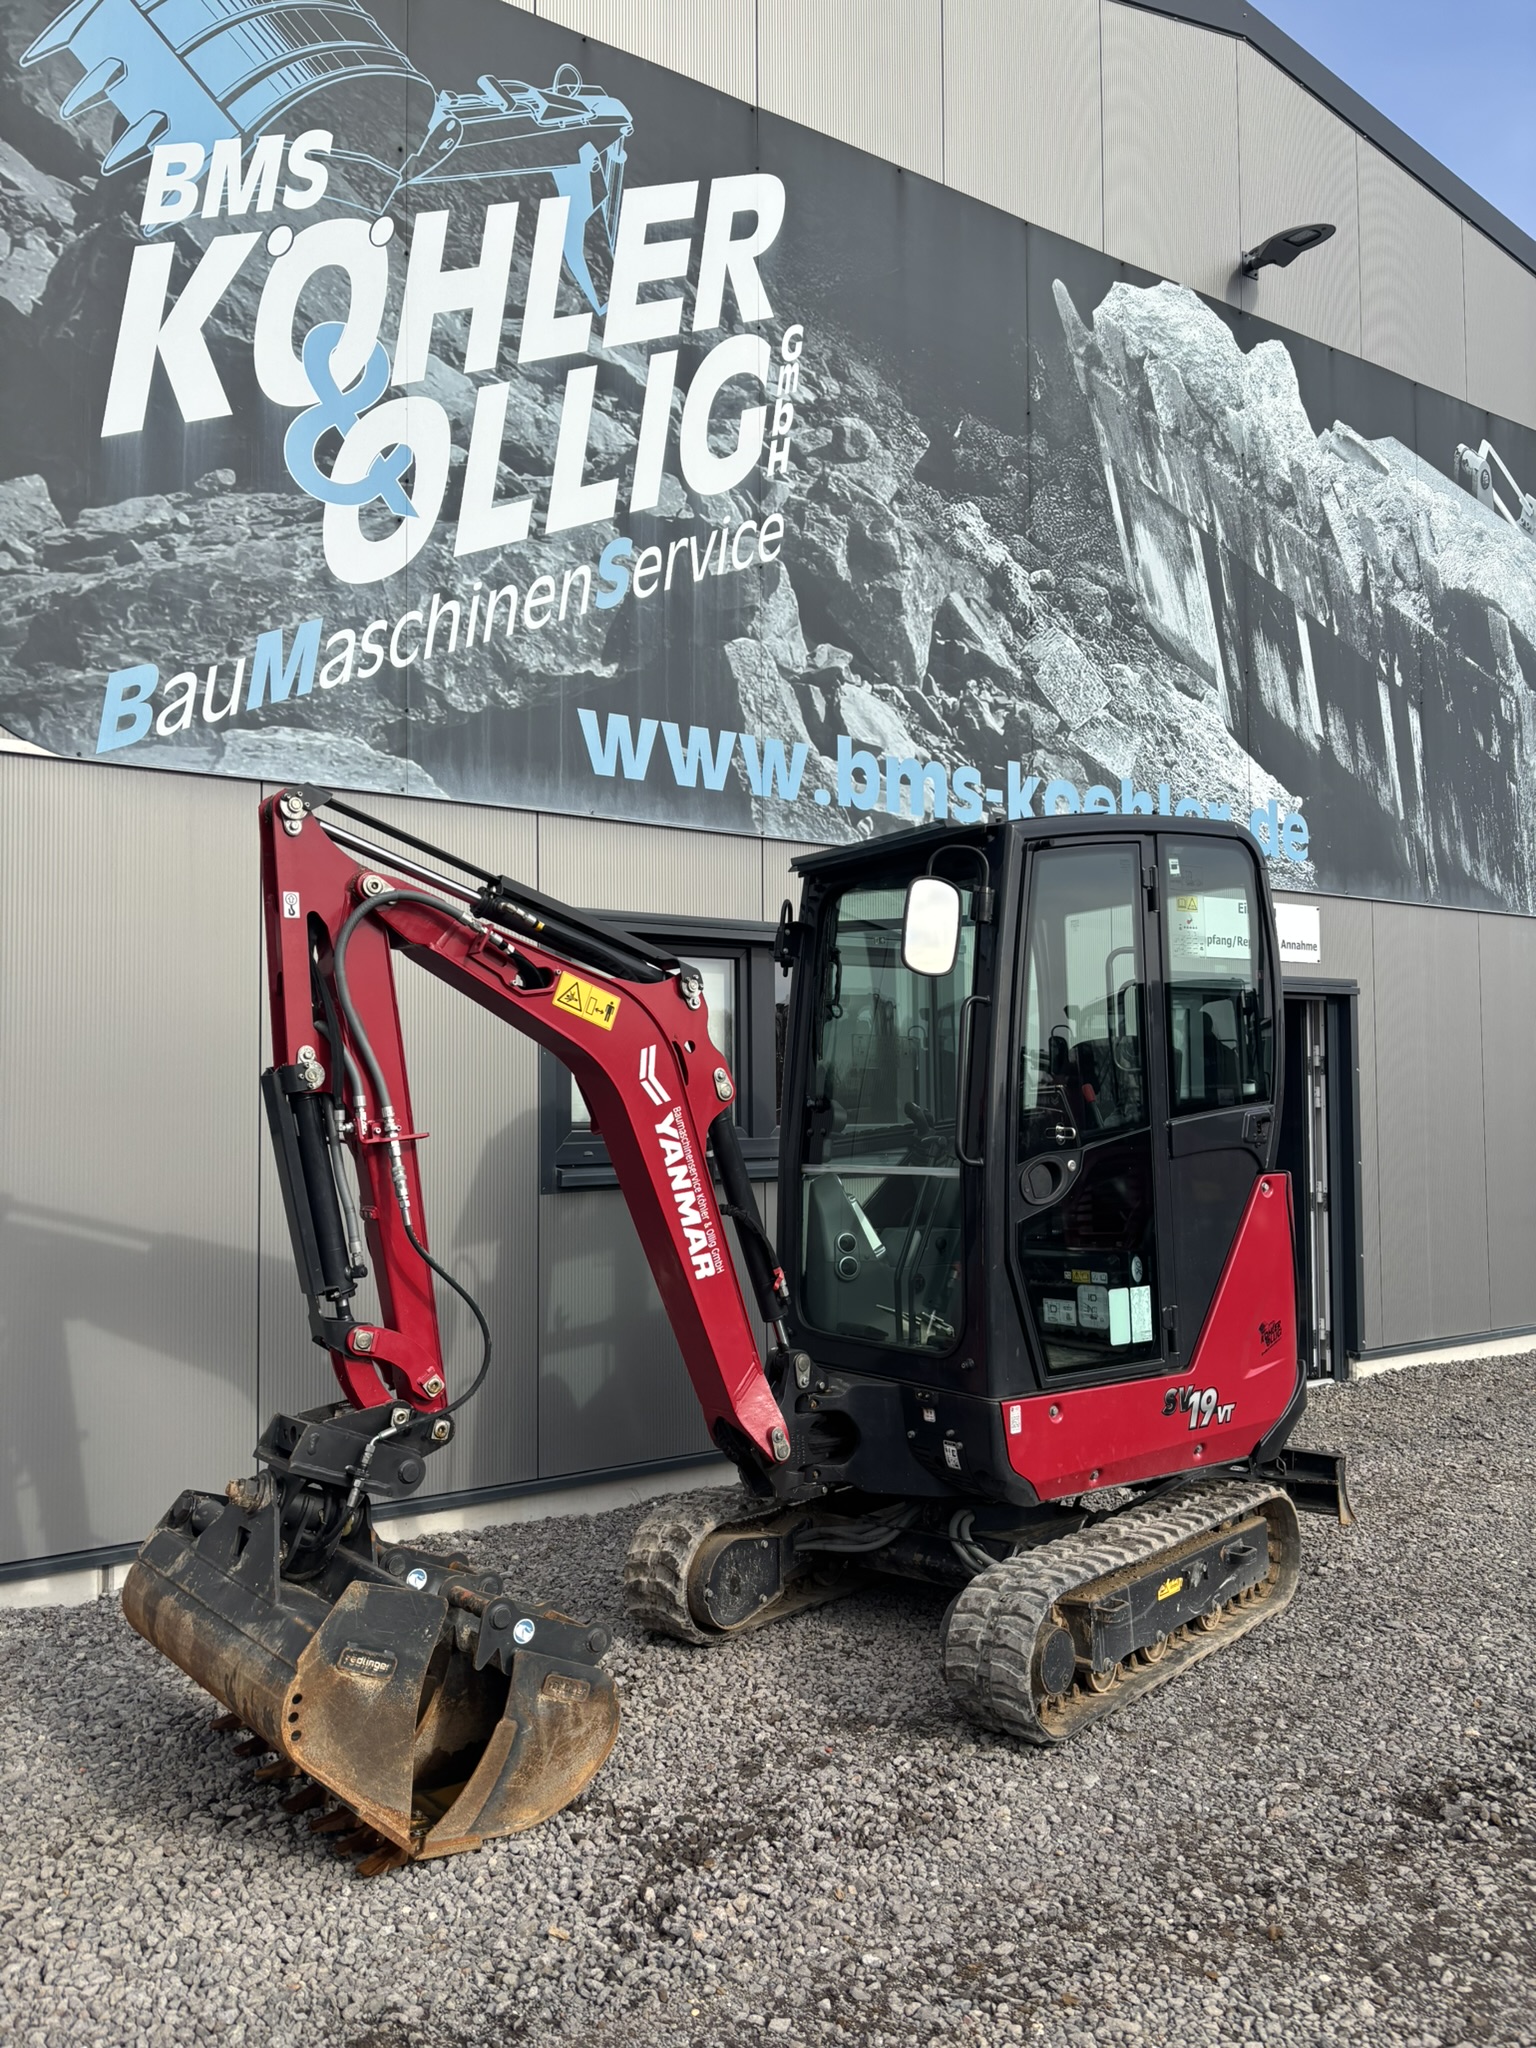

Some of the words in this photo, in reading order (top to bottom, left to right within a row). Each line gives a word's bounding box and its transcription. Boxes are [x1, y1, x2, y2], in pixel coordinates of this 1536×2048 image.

[140, 129, 334, 227] BMS
[101, 173, 786, 438] KÖHLER
[322, 333, 772, 584] OLLIG
[766, 323, 804, 477] GmbH
[95, 512, 785, 755] BauMaschinenService
[1281, 939, 1318, 952] Annahme
[655, 1111, 716, 1280] YANMAR
[672, 1105, 702, 1194] Baumaschinenservice
[696, 1192, 710, 1220] Köhler
[711, 1247, 725, 1275] GmbH
